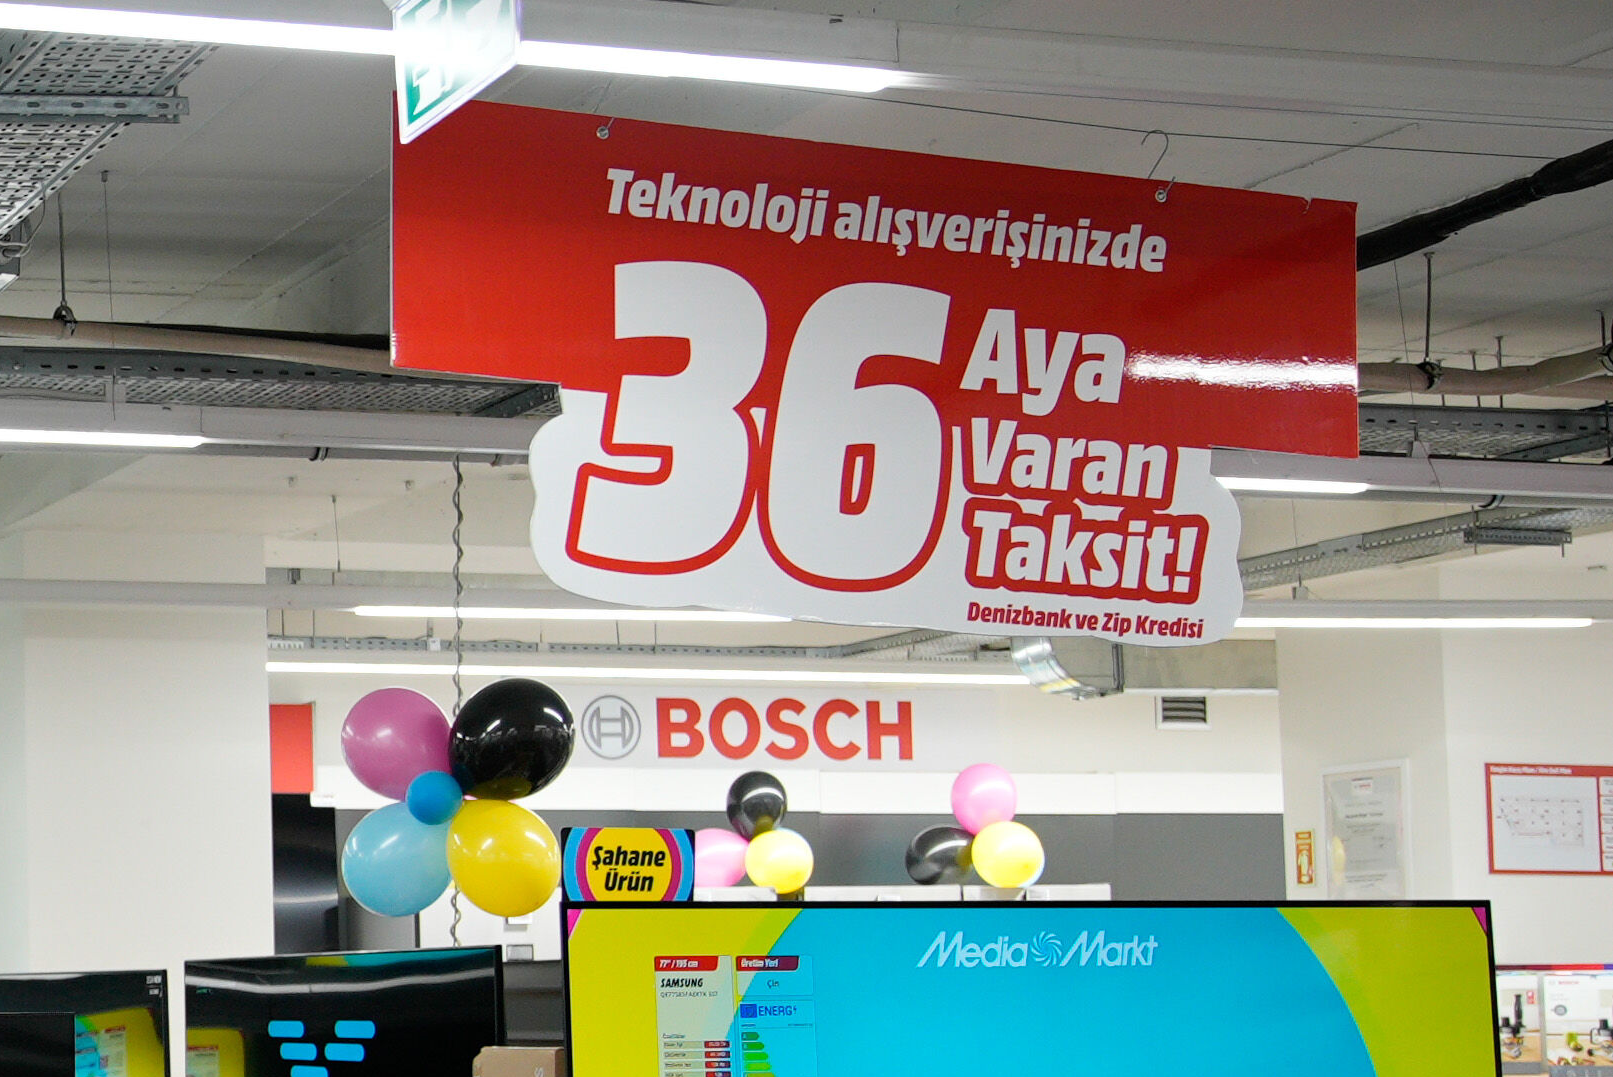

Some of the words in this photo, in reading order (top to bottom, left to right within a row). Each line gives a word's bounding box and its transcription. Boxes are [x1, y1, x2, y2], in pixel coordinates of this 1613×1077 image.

[606, 168, 830, 245] Teknoloji
[834, 196, 1168, 272] alışverişinizde
[959, 308, 1126, 416] Aya
[574, 258, 954, 584] 36
[971, 416, 1168, 499] Varan
[973, 509, 1199, 593] Taksit!
[967, 602, 1073, 629] Denizbank
[1076, 612, 1099, 631] ve
[1101, 612, 1132, 637] Zip
[1135, 615, 1204, 638] Kredisi
[655, 696, 914, 761] BOSCH
[592, 845, 667, 871] Şahane
[604, 868, 655, 892] Ürün
[916, 930, 1028, 968] Media
[1059, 930, 1159, 967] Markt
[660, 977, 704, 988] SAMSUNG
[758, 1005, 793, 1017] ENERG
